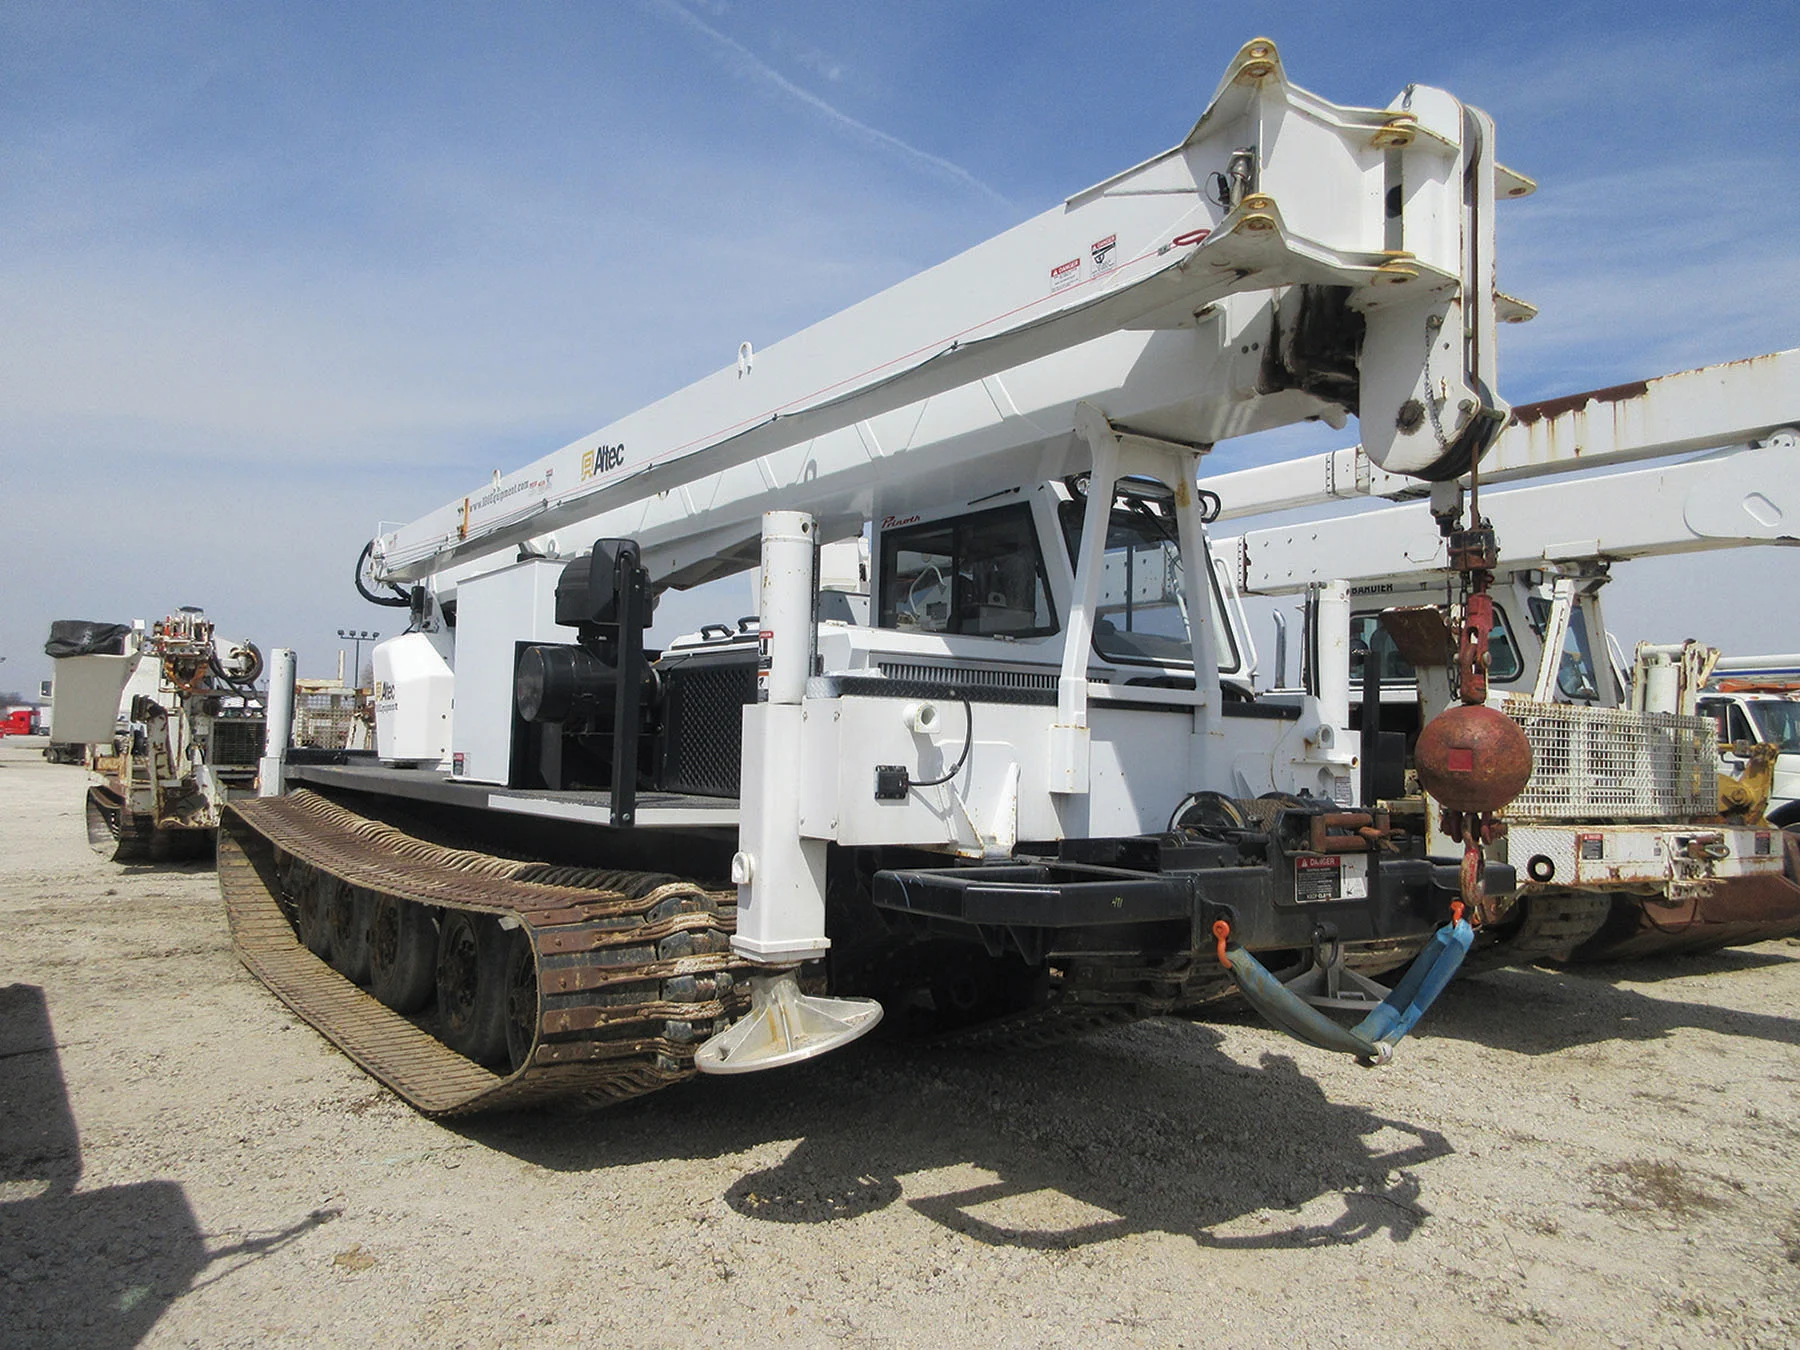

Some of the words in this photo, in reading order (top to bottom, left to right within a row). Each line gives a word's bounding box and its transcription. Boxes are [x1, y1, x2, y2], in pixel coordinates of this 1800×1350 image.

[1058, 260, 1080, 275] DANGER
[593, 443, 625, 475] Altec
[881, 515, 921, 529] Prinoth
[1351, 583, 1393, 595] BARDIER
[1309, 857, 1335, 867] DANGER
